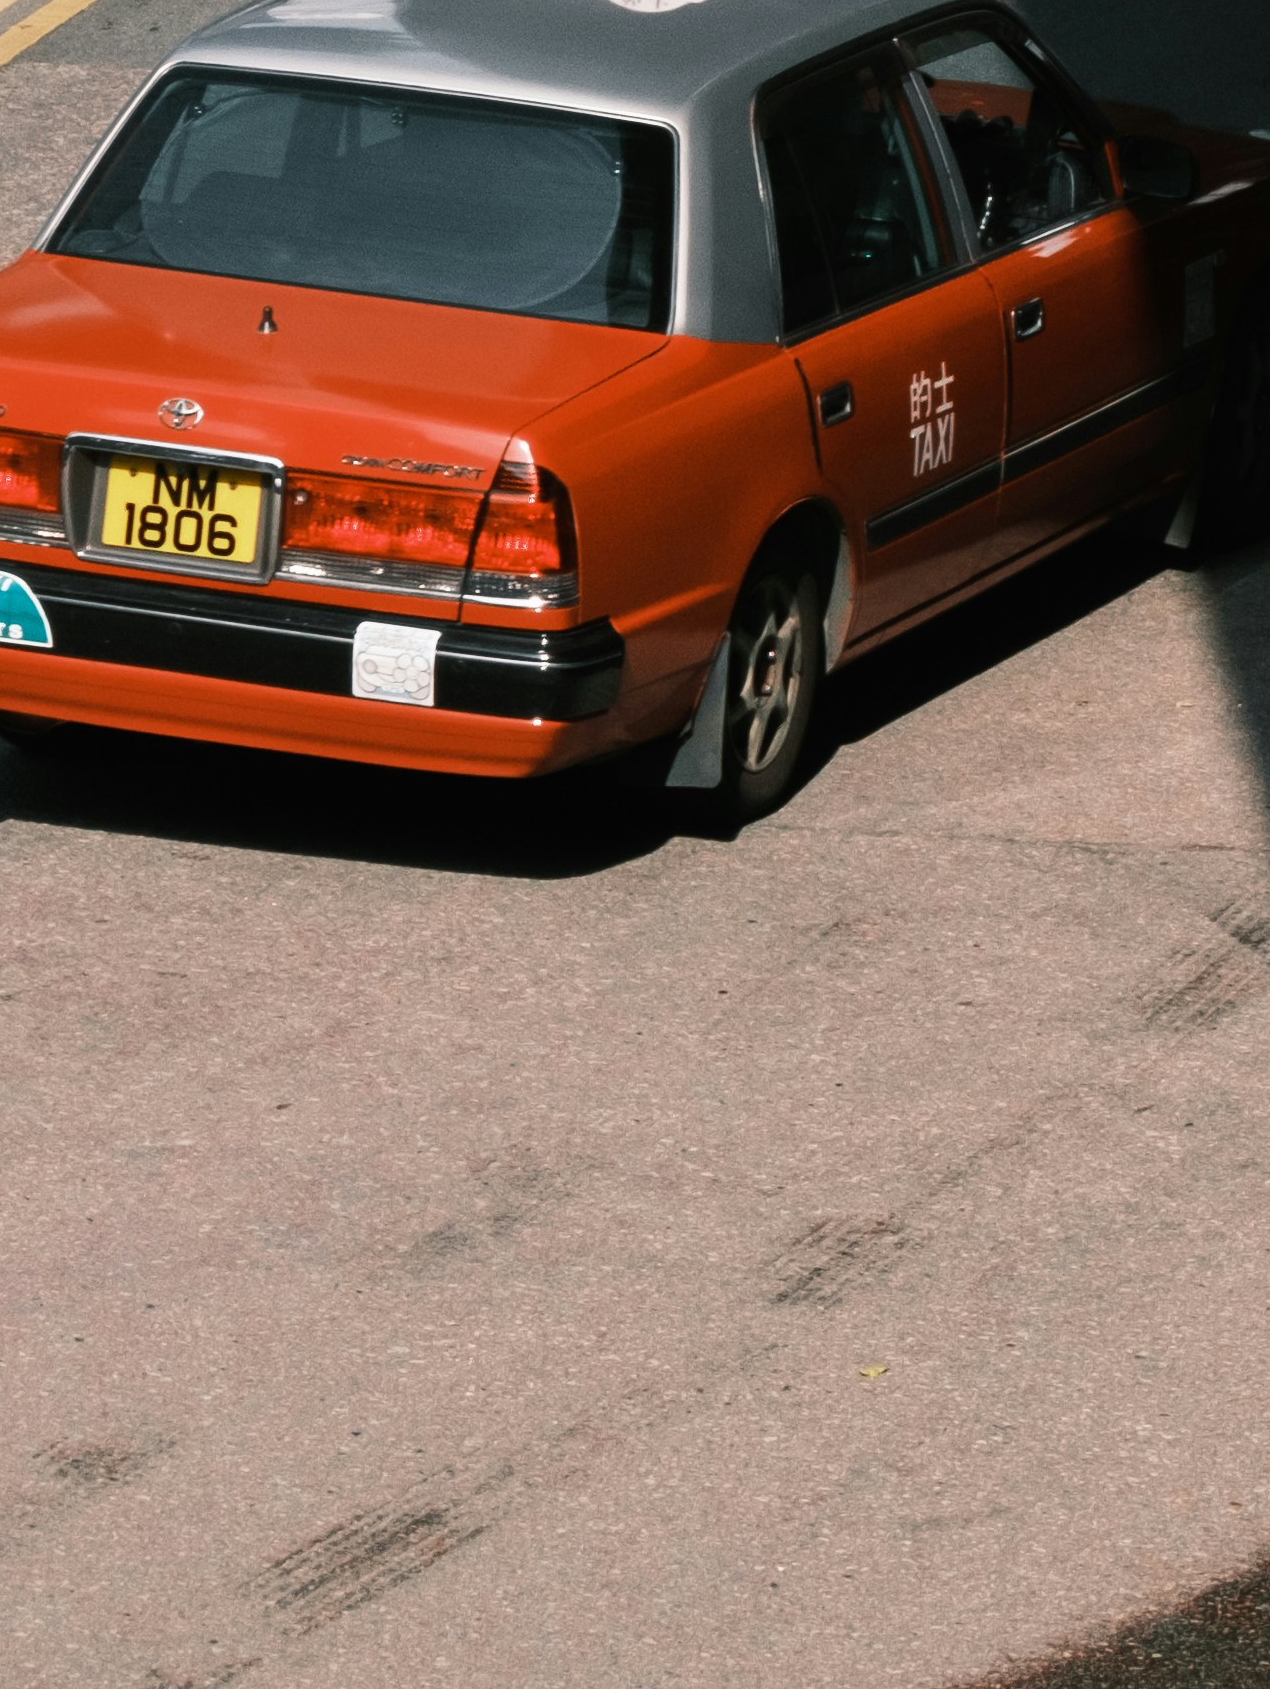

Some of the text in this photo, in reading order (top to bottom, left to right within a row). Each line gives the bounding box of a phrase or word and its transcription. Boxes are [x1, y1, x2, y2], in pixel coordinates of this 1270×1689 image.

[910, 361, 955, 423] 的士
[910, 412, 955, 477] TAXI
[152, 463, 218, 511] NM
[125, 502, 237, 557] 1806
